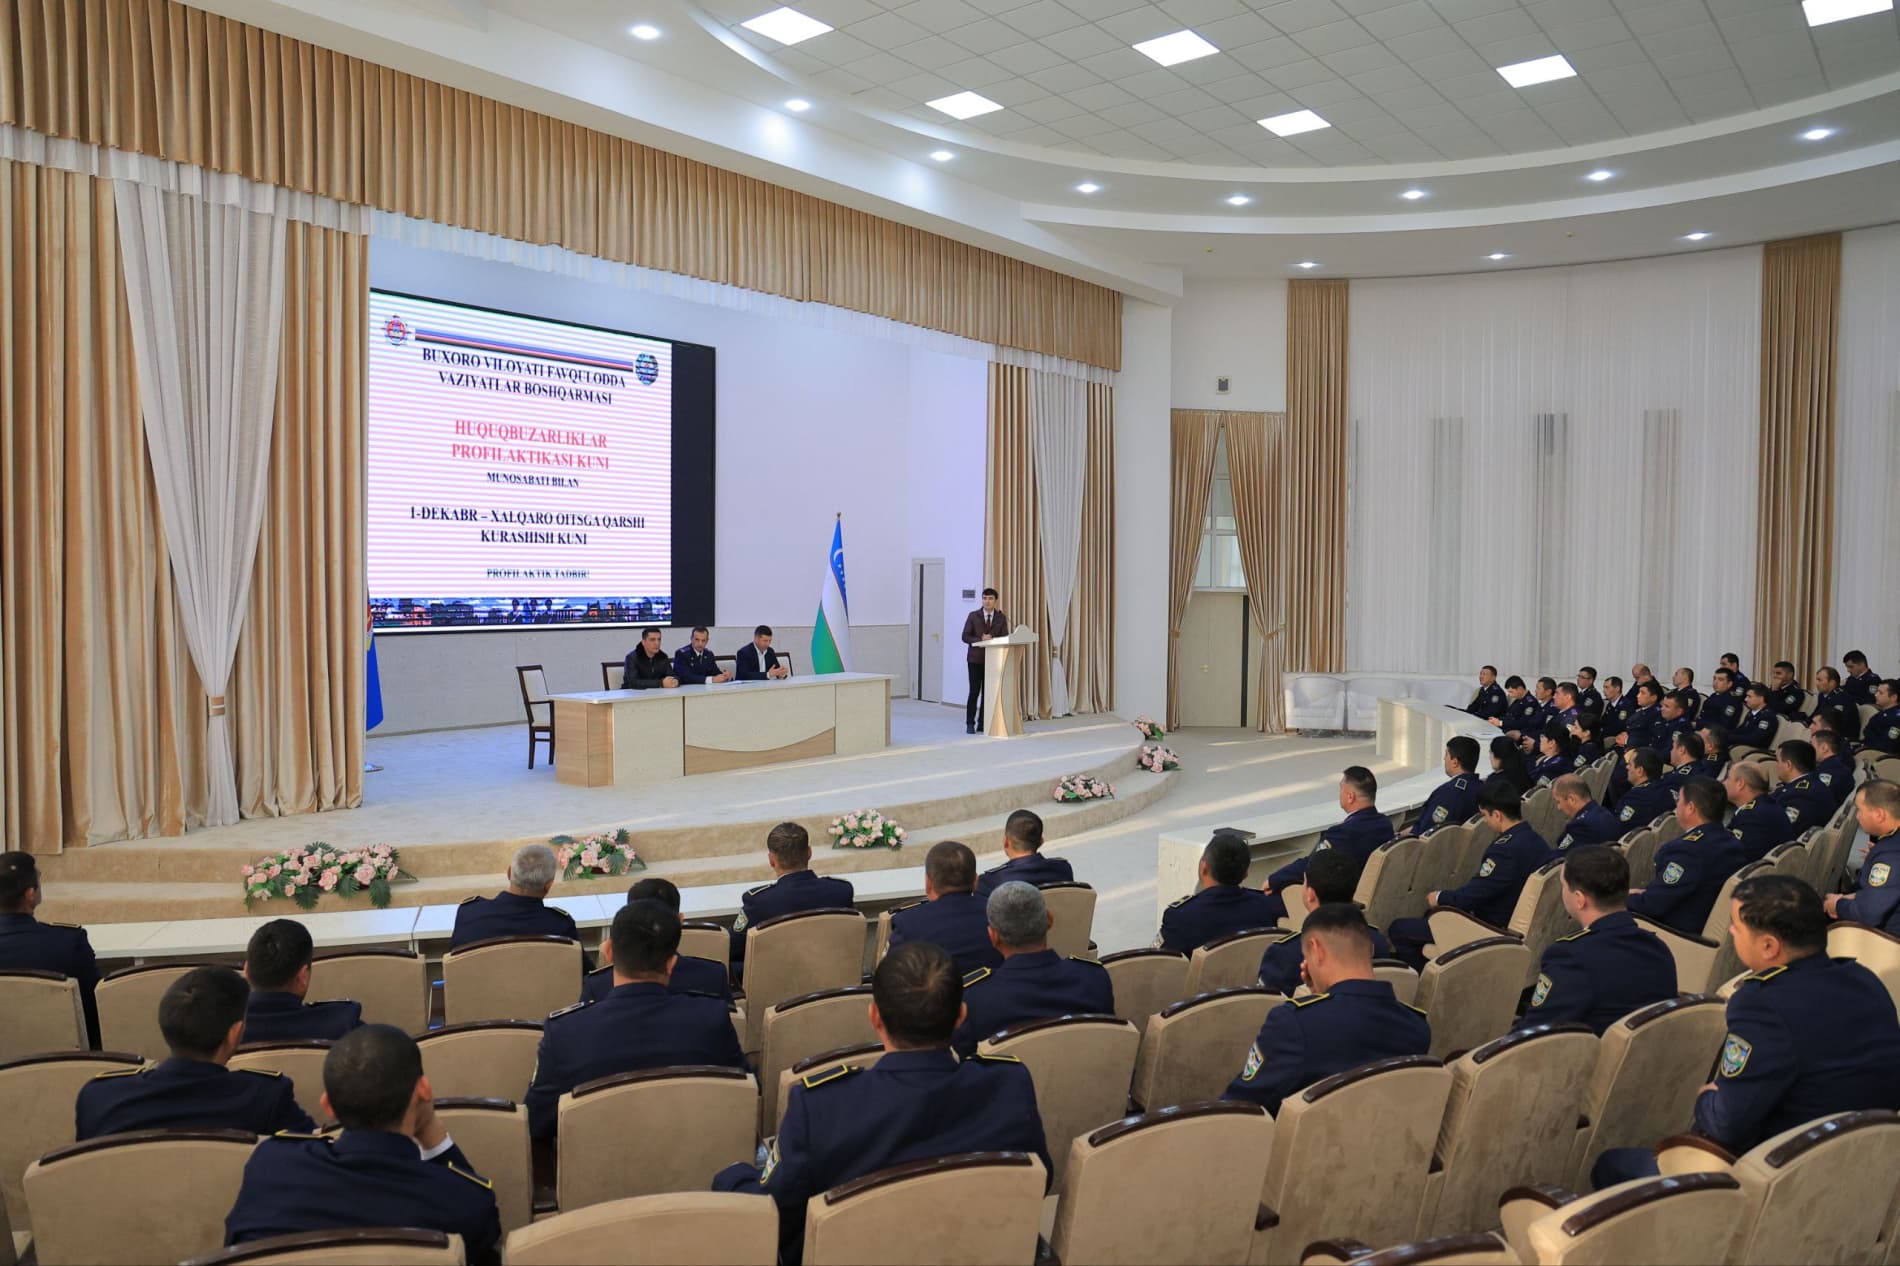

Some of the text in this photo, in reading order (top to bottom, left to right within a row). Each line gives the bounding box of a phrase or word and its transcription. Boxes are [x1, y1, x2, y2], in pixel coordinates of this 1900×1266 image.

[423, 348, 480, 367] BUXORO
[484, 356, 544, 377] VILOYATI
[439, 371, 612, 404] VAZIYATLAR BOSHQARMASI
[455, 419, 607, 448] HUQUQBUZARLIKLAR
[452, 443, 609, 469] PROFILAKTIKASI KUNI
[487, 472, 579, 488] MUNOSABATI BILAN
[411, 506, 478, 522] 1-DEKABR
[491, 510, 553, 526] XALQARO
[602, 515, 645, 529] QARSHI
[481, 530, 587, 545] KURASHISH KUNI
